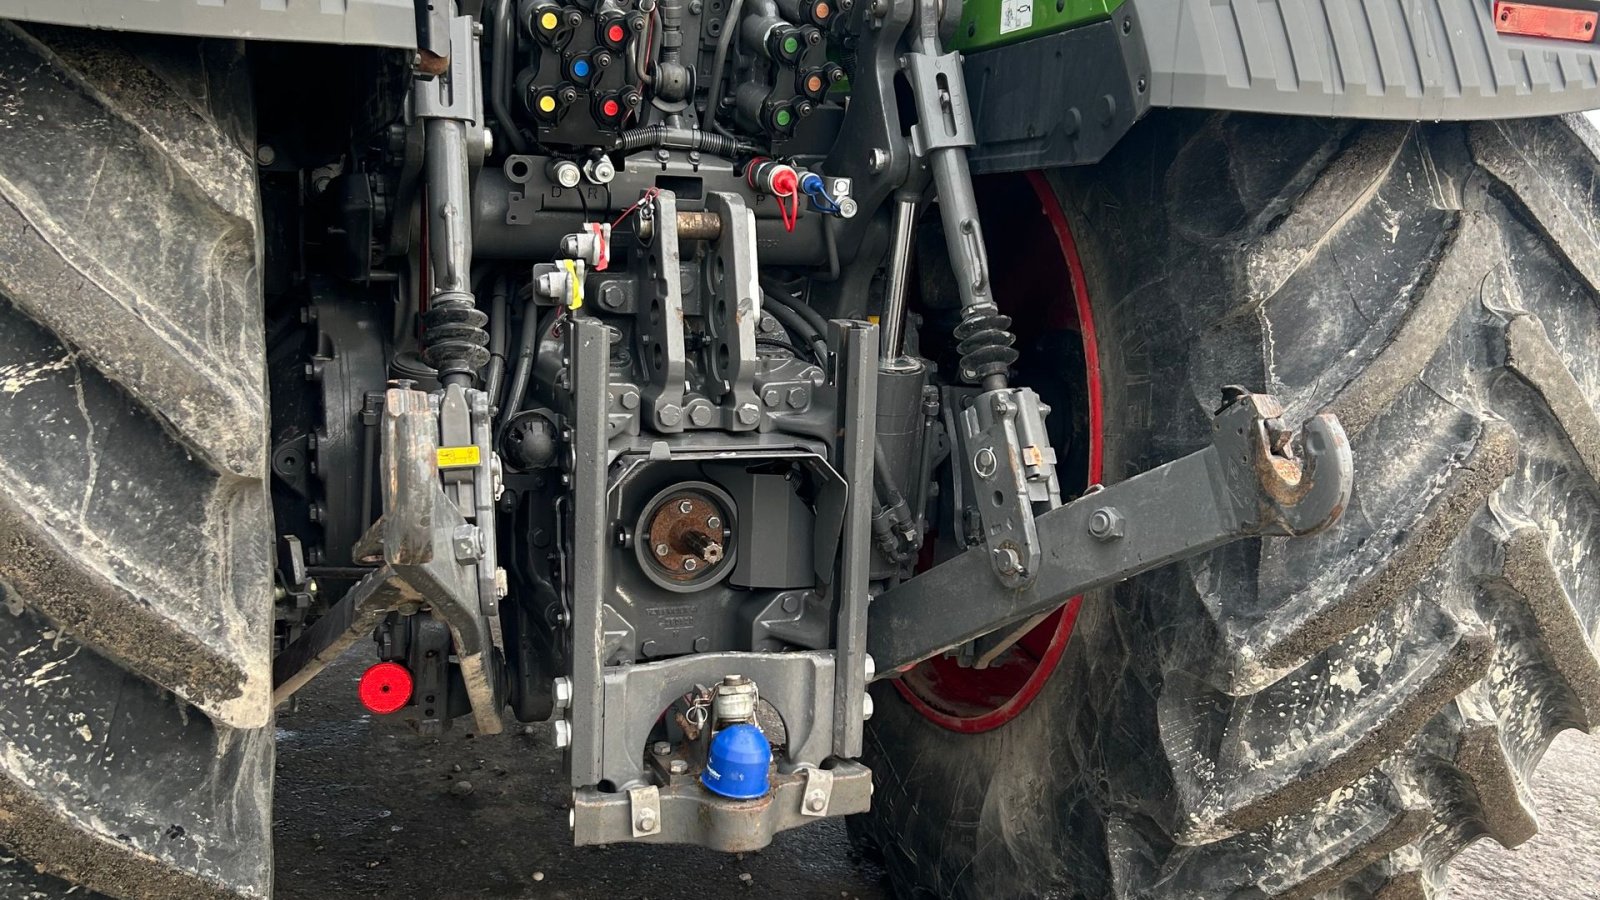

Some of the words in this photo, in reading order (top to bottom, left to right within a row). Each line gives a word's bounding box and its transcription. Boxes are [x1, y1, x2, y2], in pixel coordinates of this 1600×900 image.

[551, 186, 562, 199] D
[587, 187, 598, 200] R
[756, 194, 766, 206] P
